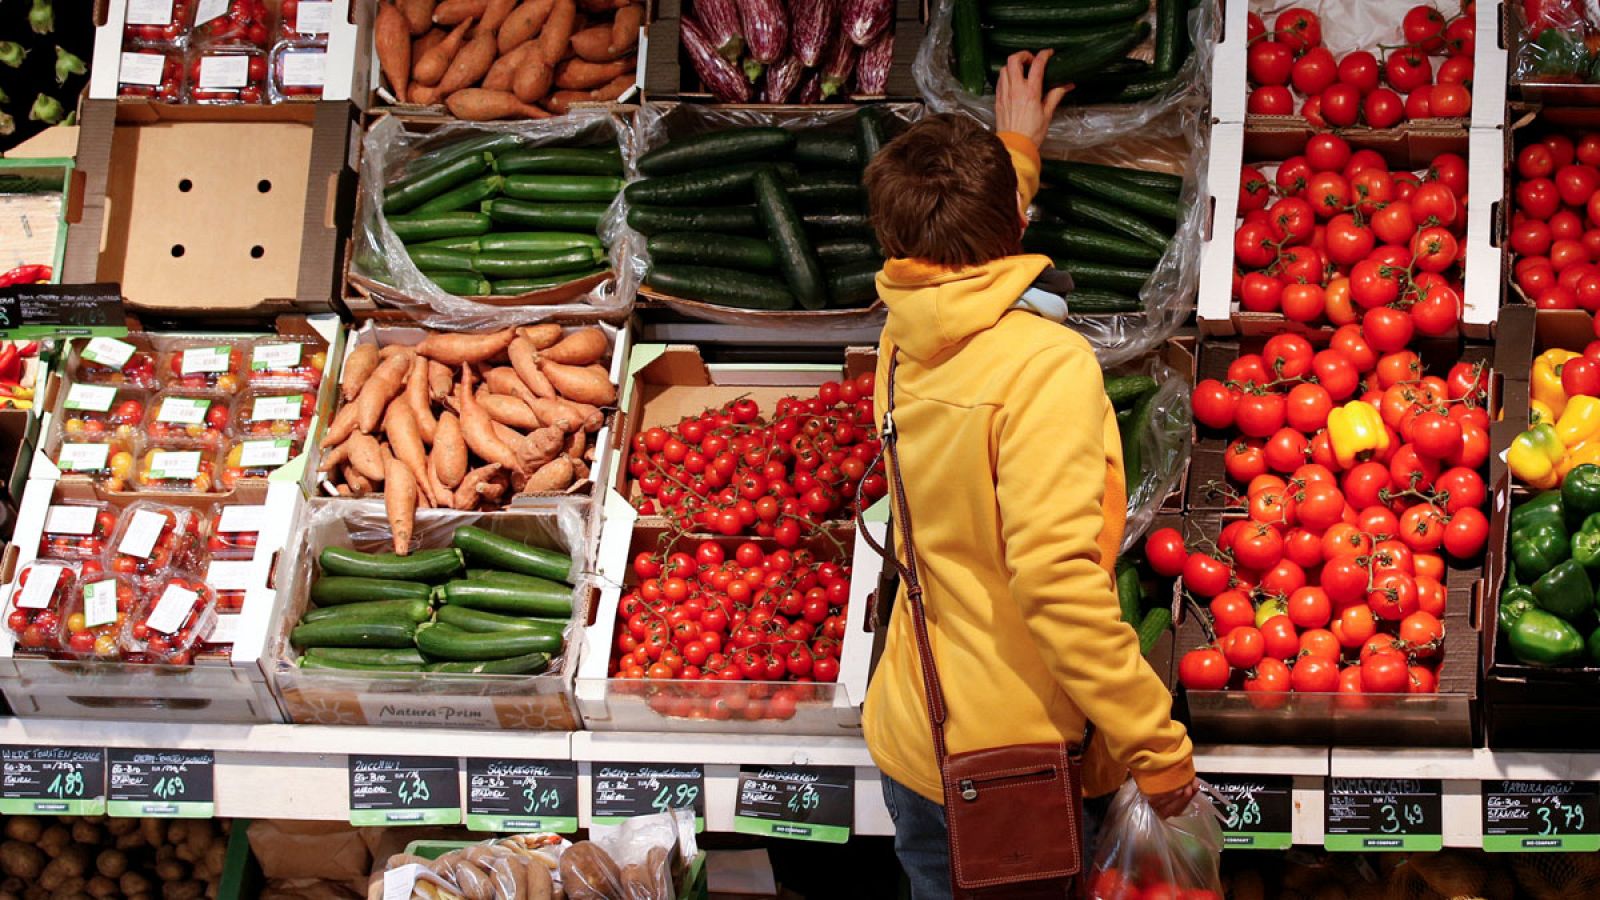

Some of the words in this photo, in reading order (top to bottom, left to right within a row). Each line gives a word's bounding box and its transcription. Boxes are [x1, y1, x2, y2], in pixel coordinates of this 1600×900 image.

[47, 771, 84, 799] 1,89
[153, 776, 185, 800] 1,69
[398, 779, 430, 805] 4,29
[523, 788, 560, 813] 3,49
[787, 791, 820, 813] 4,99
[1226, 802, 1261, 830] 3,69
[1536, 804, 1585, 837] 3,79
